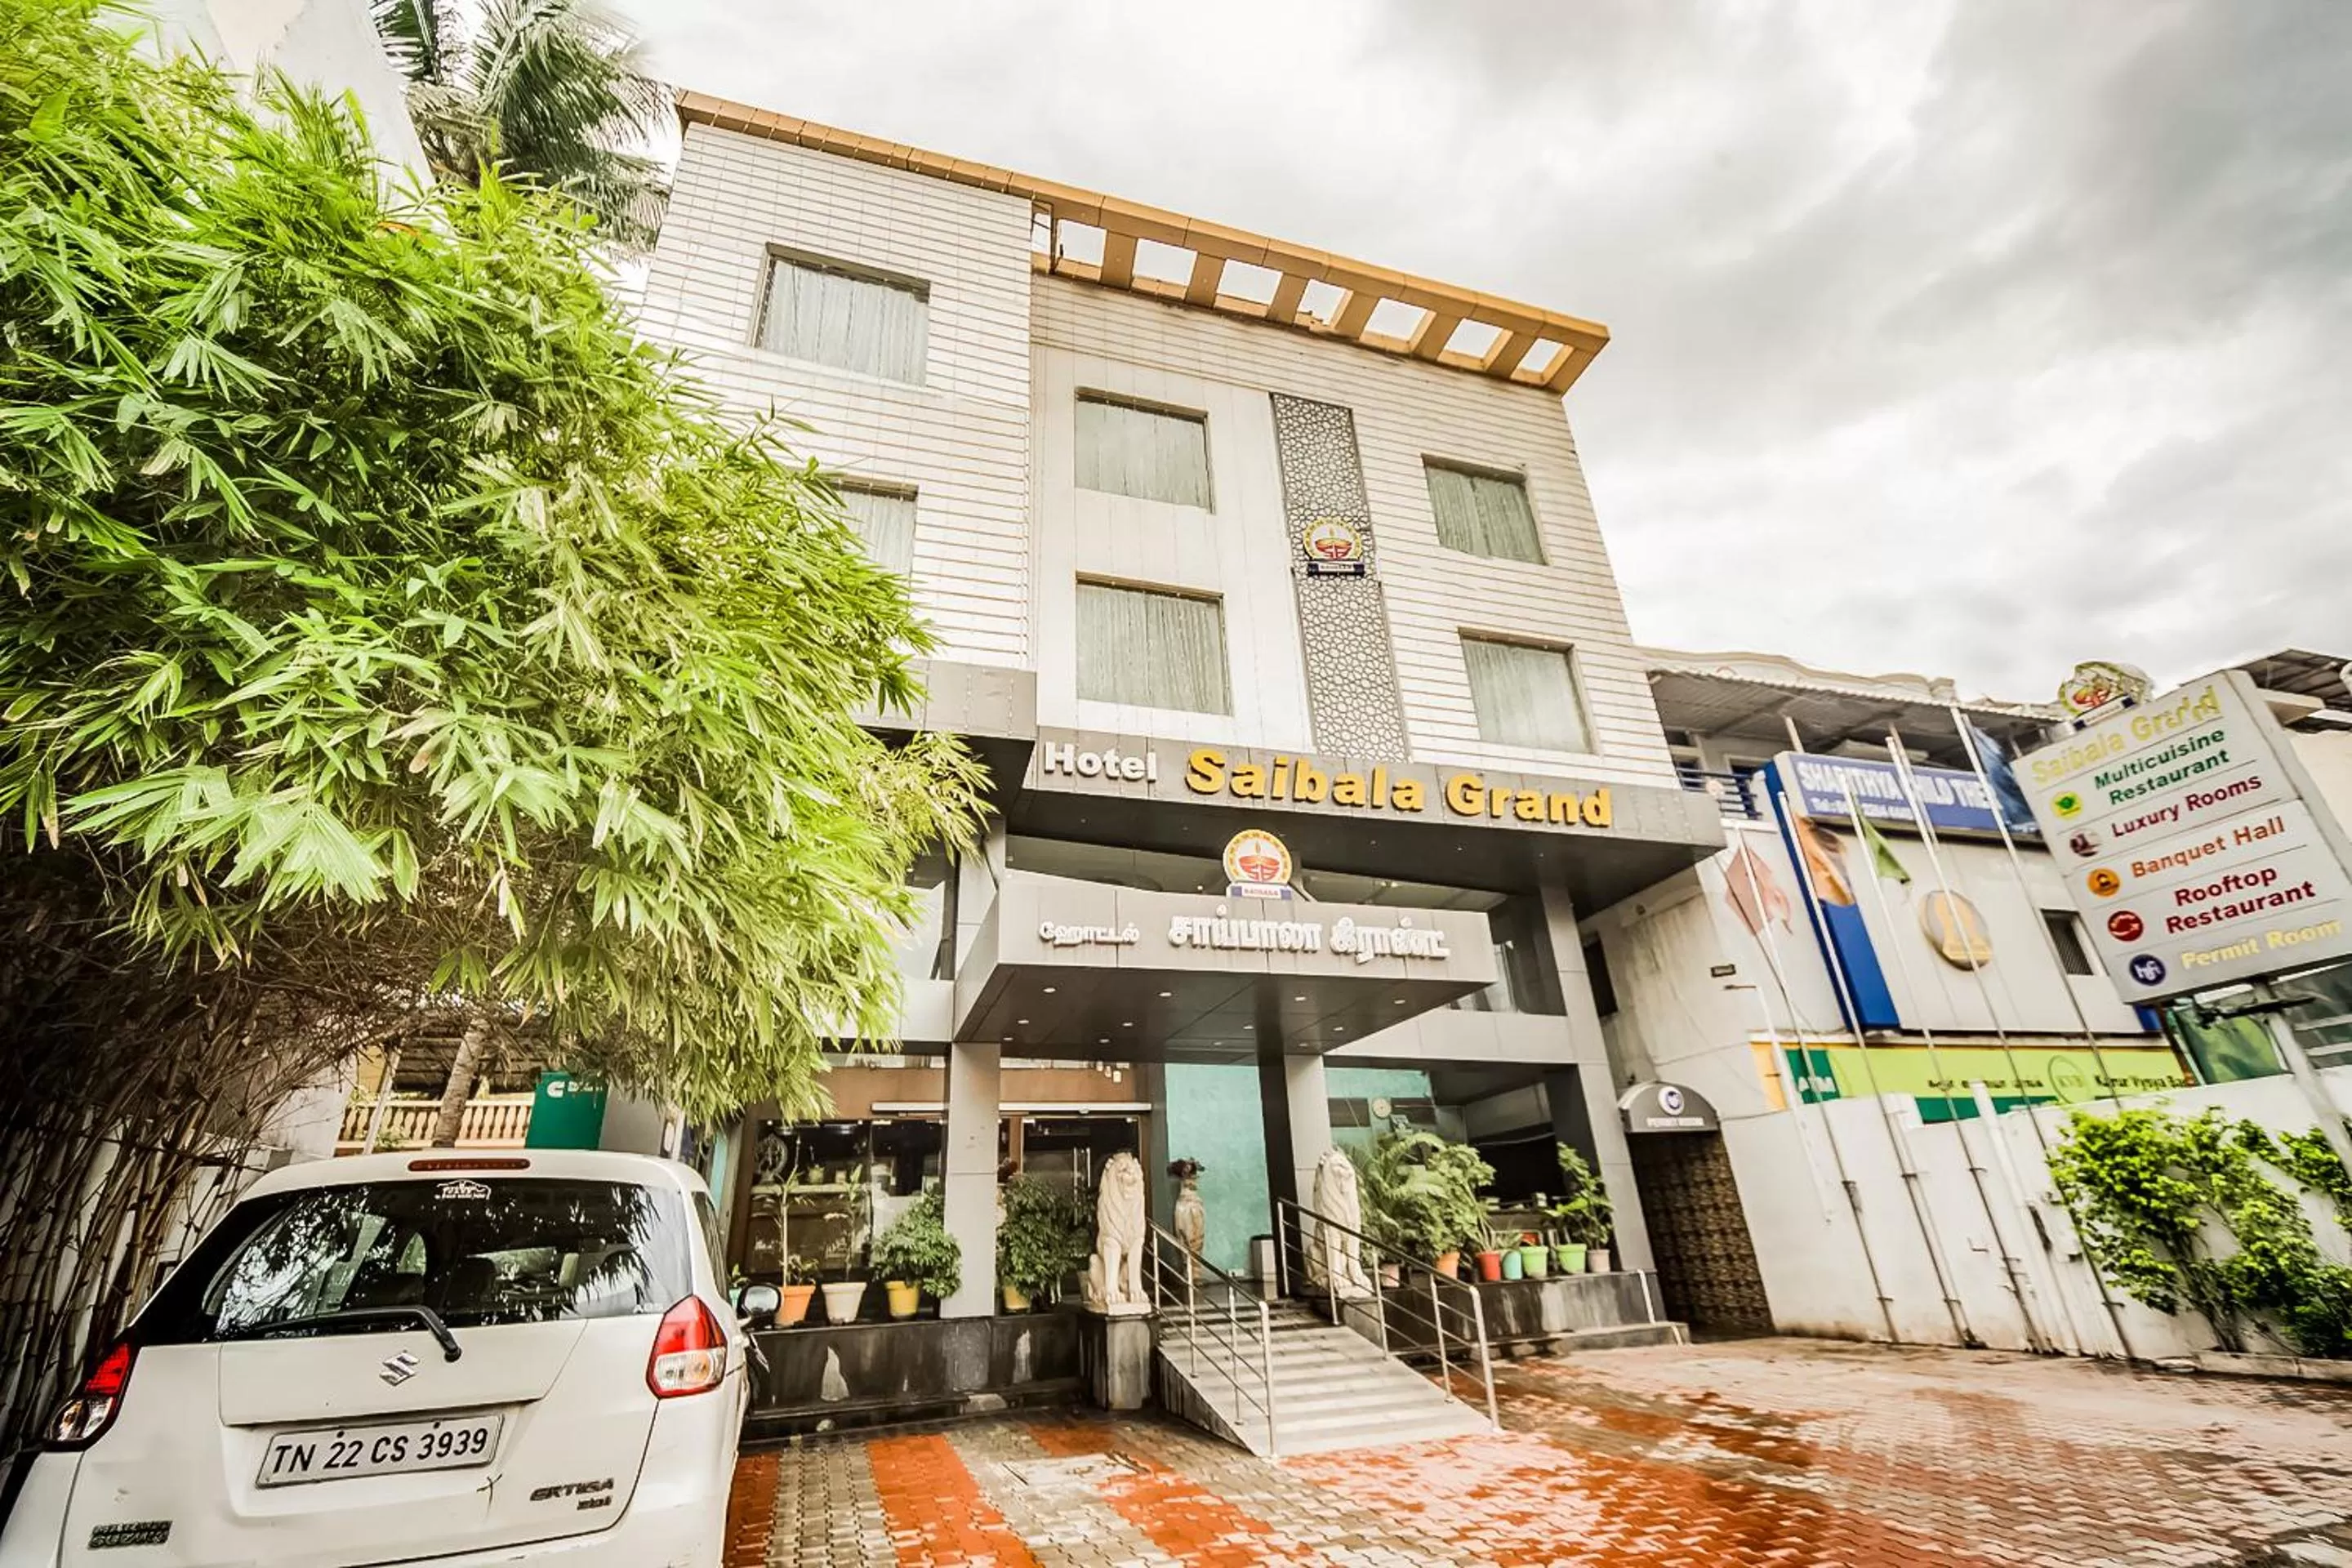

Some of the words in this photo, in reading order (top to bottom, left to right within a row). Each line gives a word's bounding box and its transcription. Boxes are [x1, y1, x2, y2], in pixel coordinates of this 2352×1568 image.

[2031, 729, 2125, 783] Saibala
[2094, 728, 2225, 790] Multicuisine
[2109, 749, 2230, 805] Restaurant
[1044, 741, 1157, 783] Hotel
[1185, 747, 1423, 812] Saibala
[1446, 773, 1613, 829] Grand
[2111, 804, 2179, 837] Luxury
[2185, 775, 2263, 812] Rooms
[2131, 835, 2227, 879] Banquet
[2234, 817, 2285, 845] Hall
[2166, 880, 2316, 934] Restaurant
[2174, 867, 2278, 907] Rooftop
[2181, 938, 2261, 969] Permit
[2266, 919, 2344, 950] Room
[272, 1443, 316, 1474] TN
[323, 1440, 363, 1469] 22
[371, 1436, 408, 1463] CS
[416, 1428, 488, 1460] 3939
